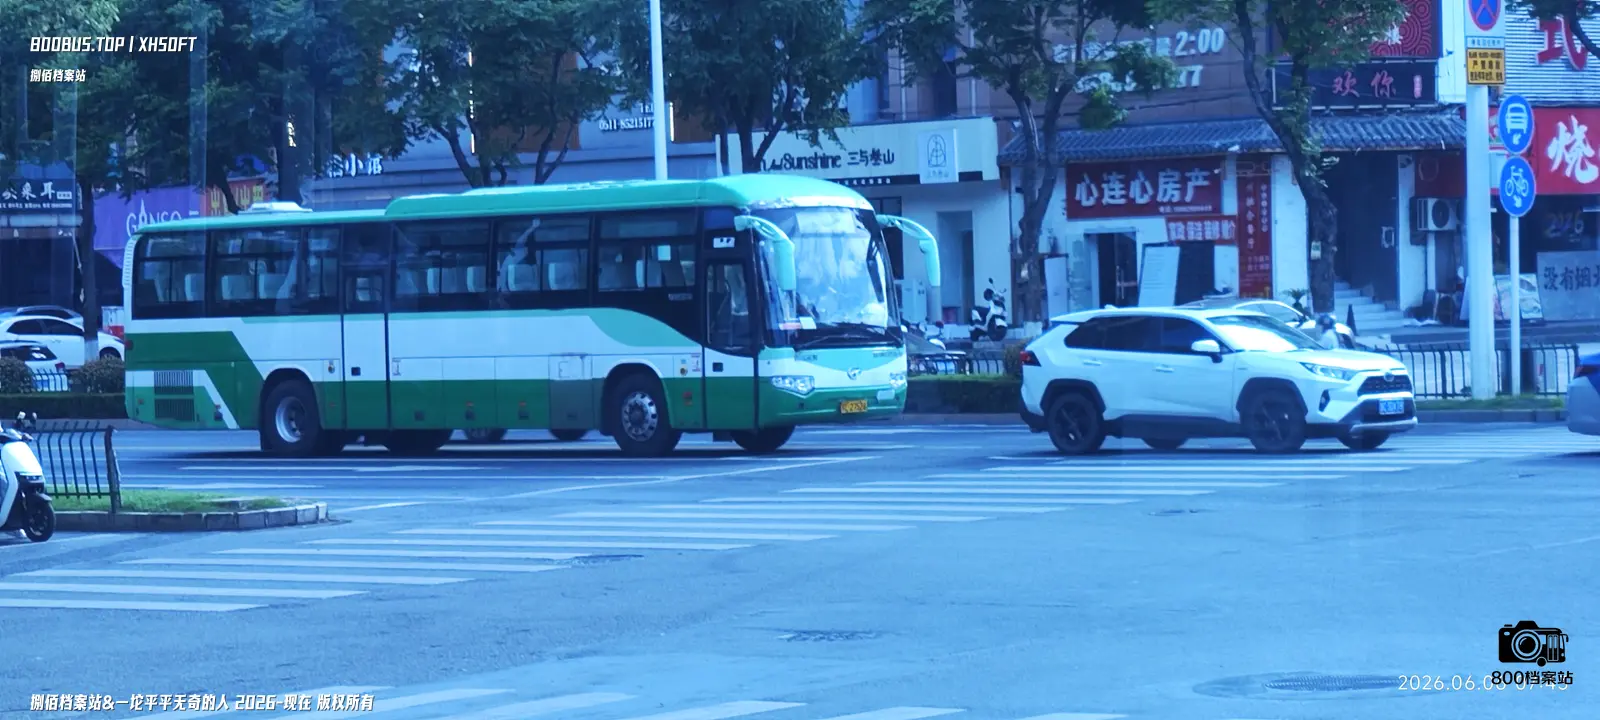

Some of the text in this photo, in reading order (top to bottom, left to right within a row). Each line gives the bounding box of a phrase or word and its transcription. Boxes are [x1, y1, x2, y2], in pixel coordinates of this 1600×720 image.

[783, 152, 842, 171] Sunshine
[1075, 168, 1210, 207] 心连心房产
